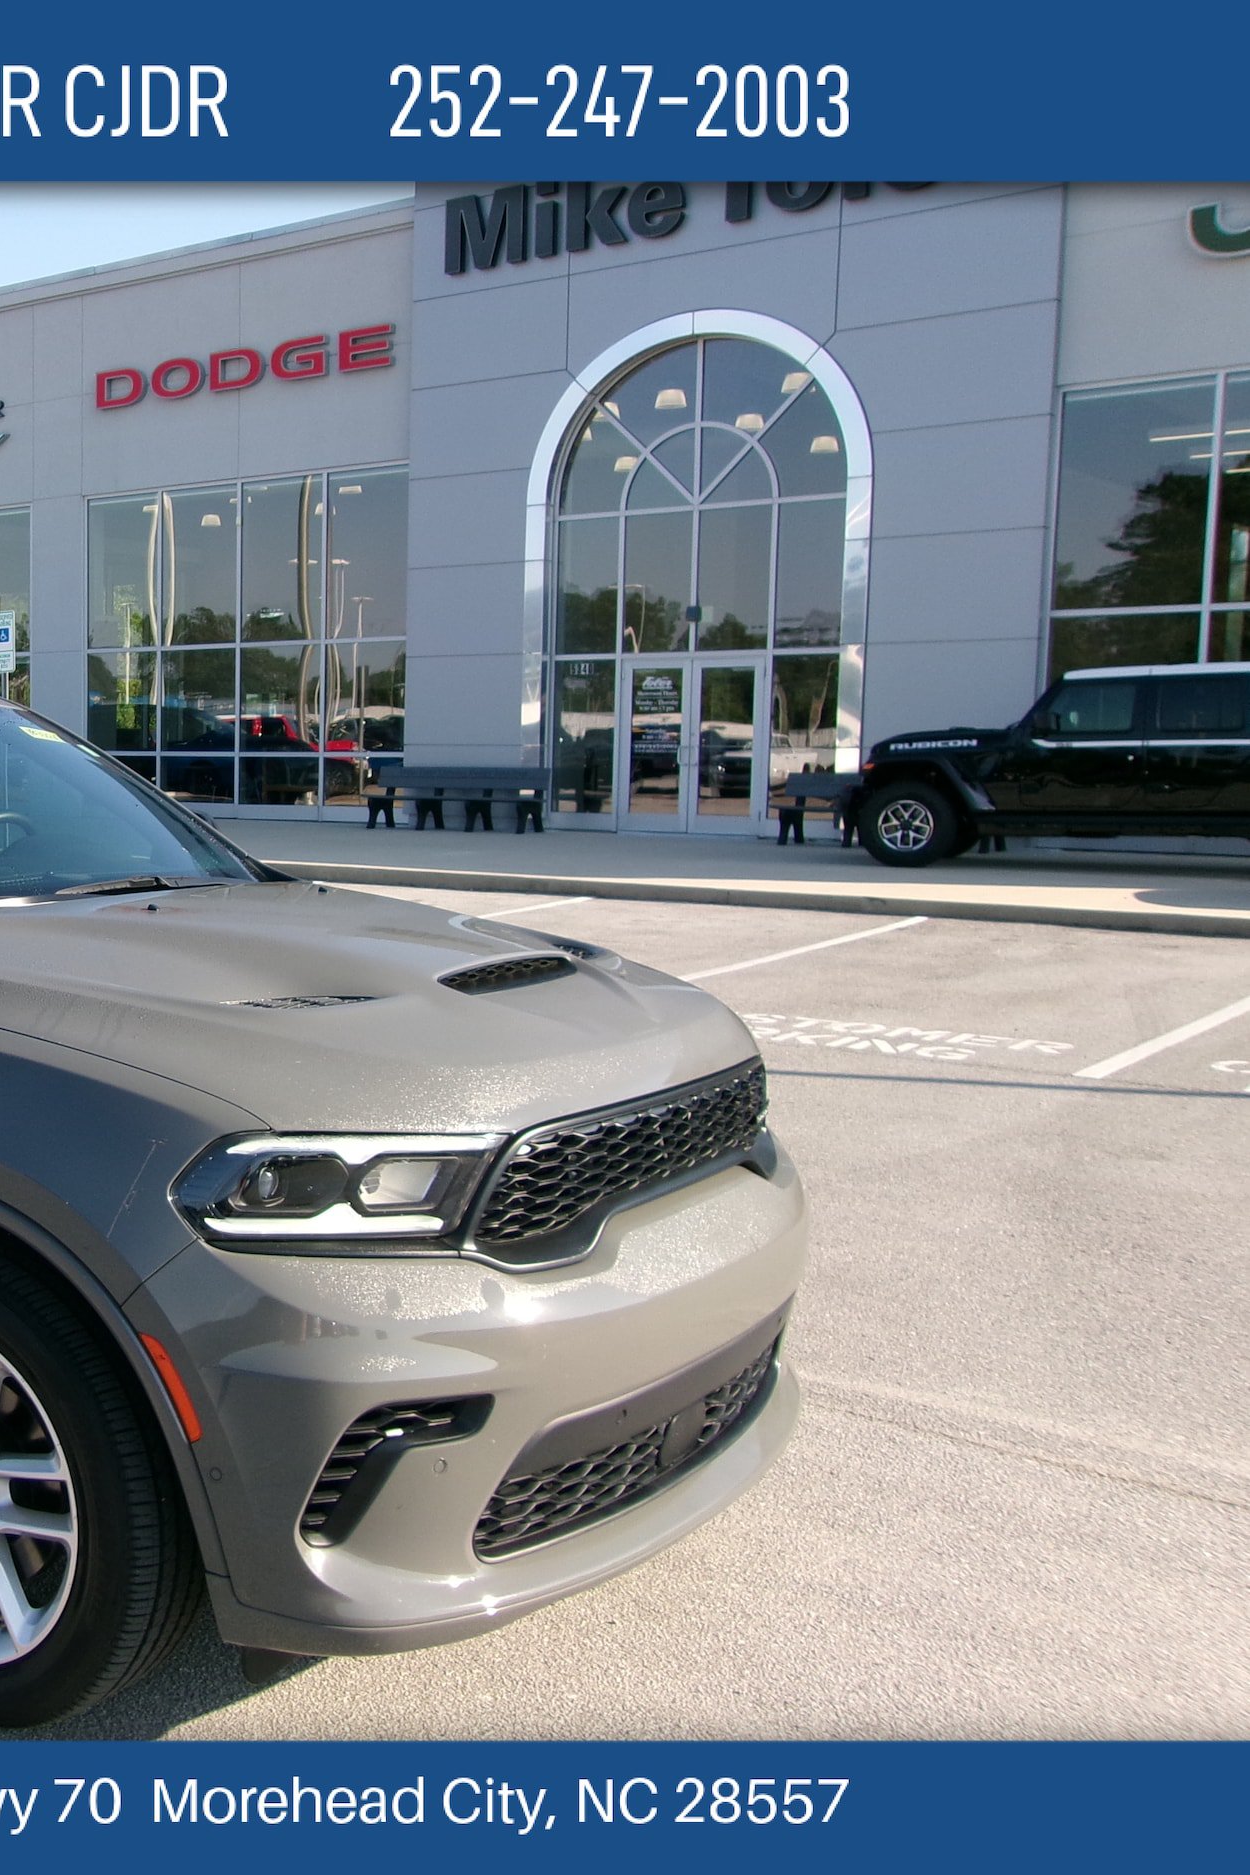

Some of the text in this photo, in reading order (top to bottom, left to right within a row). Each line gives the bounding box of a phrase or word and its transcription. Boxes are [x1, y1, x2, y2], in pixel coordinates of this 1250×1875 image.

[444, 181, 688, 275] Mike
[96, 323, 395, 409] DODGE
[889, 738, 978, 751] RUBICON
[742, 1012, 1075, 1054] STOMER
